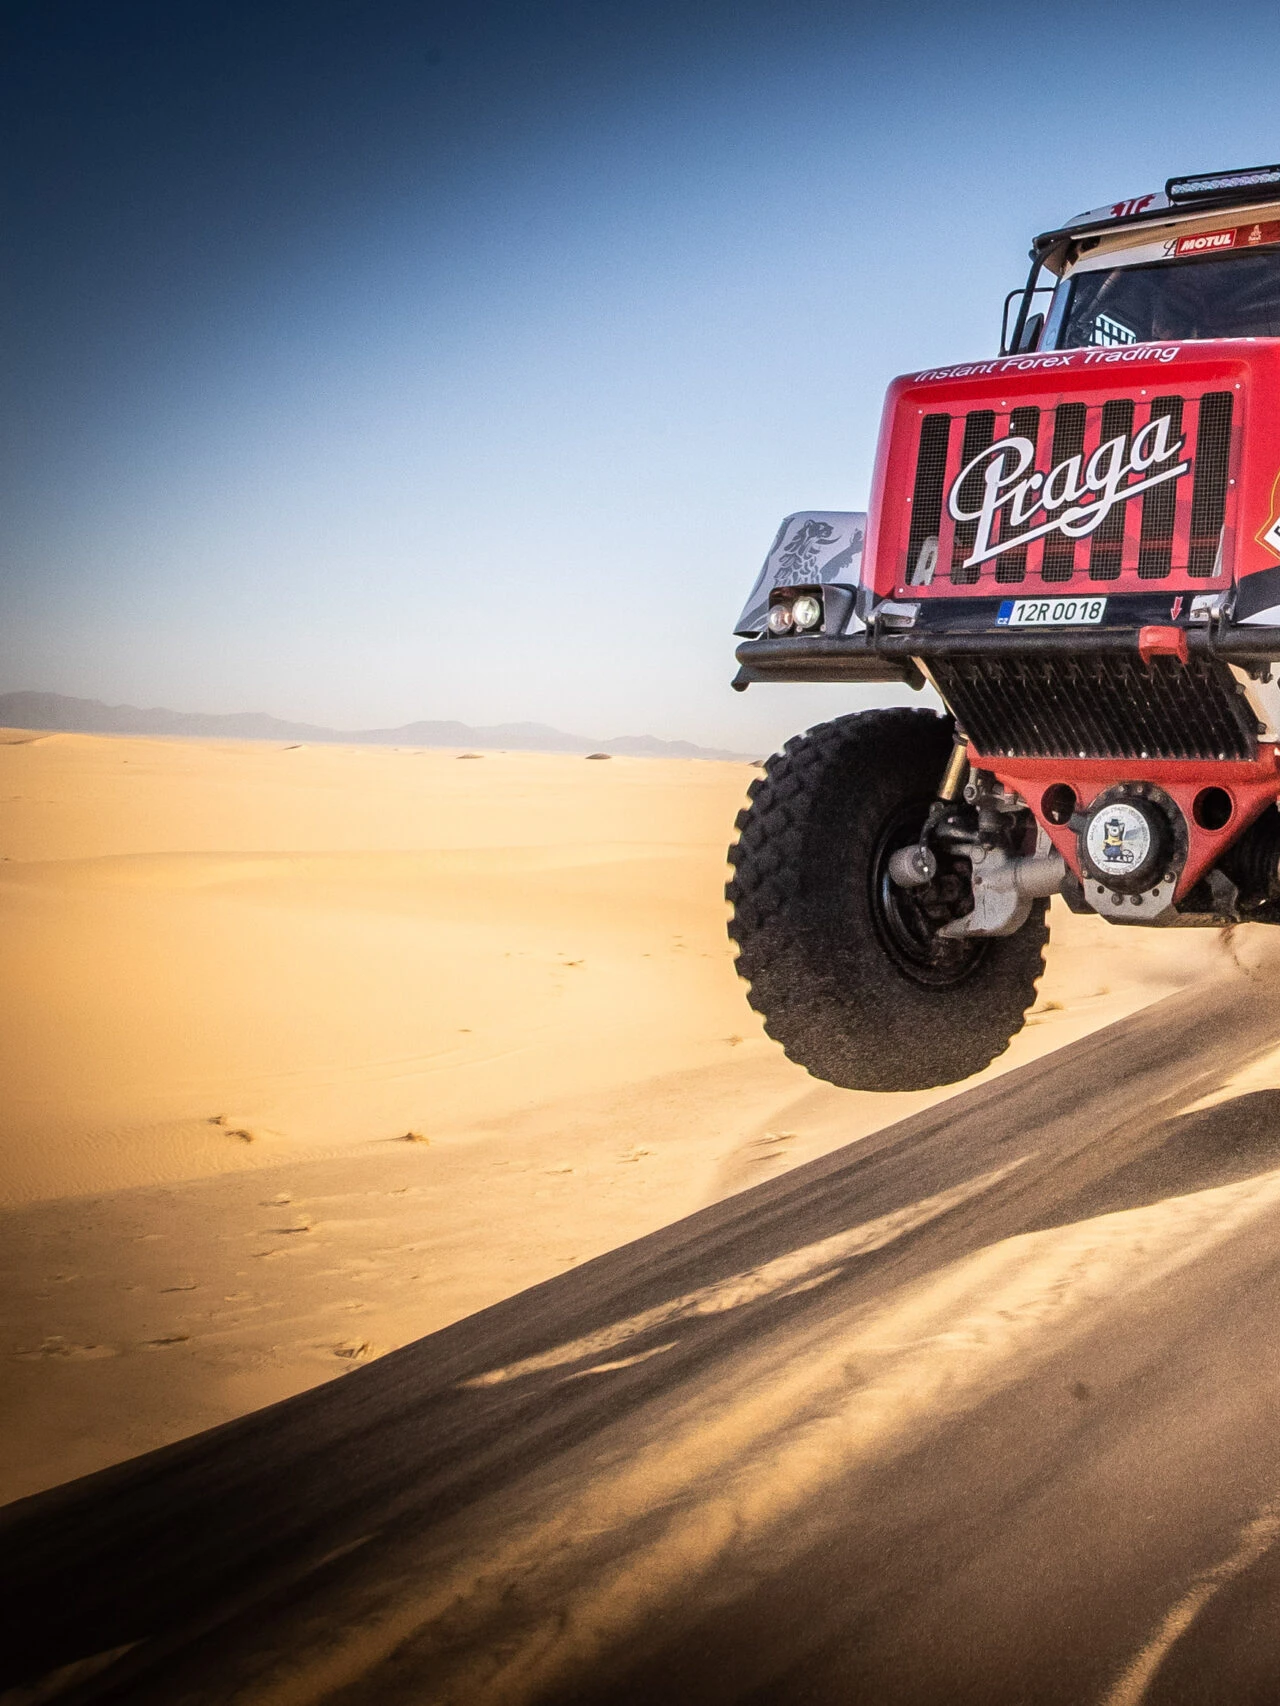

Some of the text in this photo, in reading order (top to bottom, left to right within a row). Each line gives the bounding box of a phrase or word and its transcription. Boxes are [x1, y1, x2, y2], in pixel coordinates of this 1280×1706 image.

[1180, 234, 1231, 251] MOTUL
[914, 345, 1181, 382] Instant Forex Trading
[949, 414, 1190, 569] Praga
[1017, 601, 1102, 622] 12R 0018
